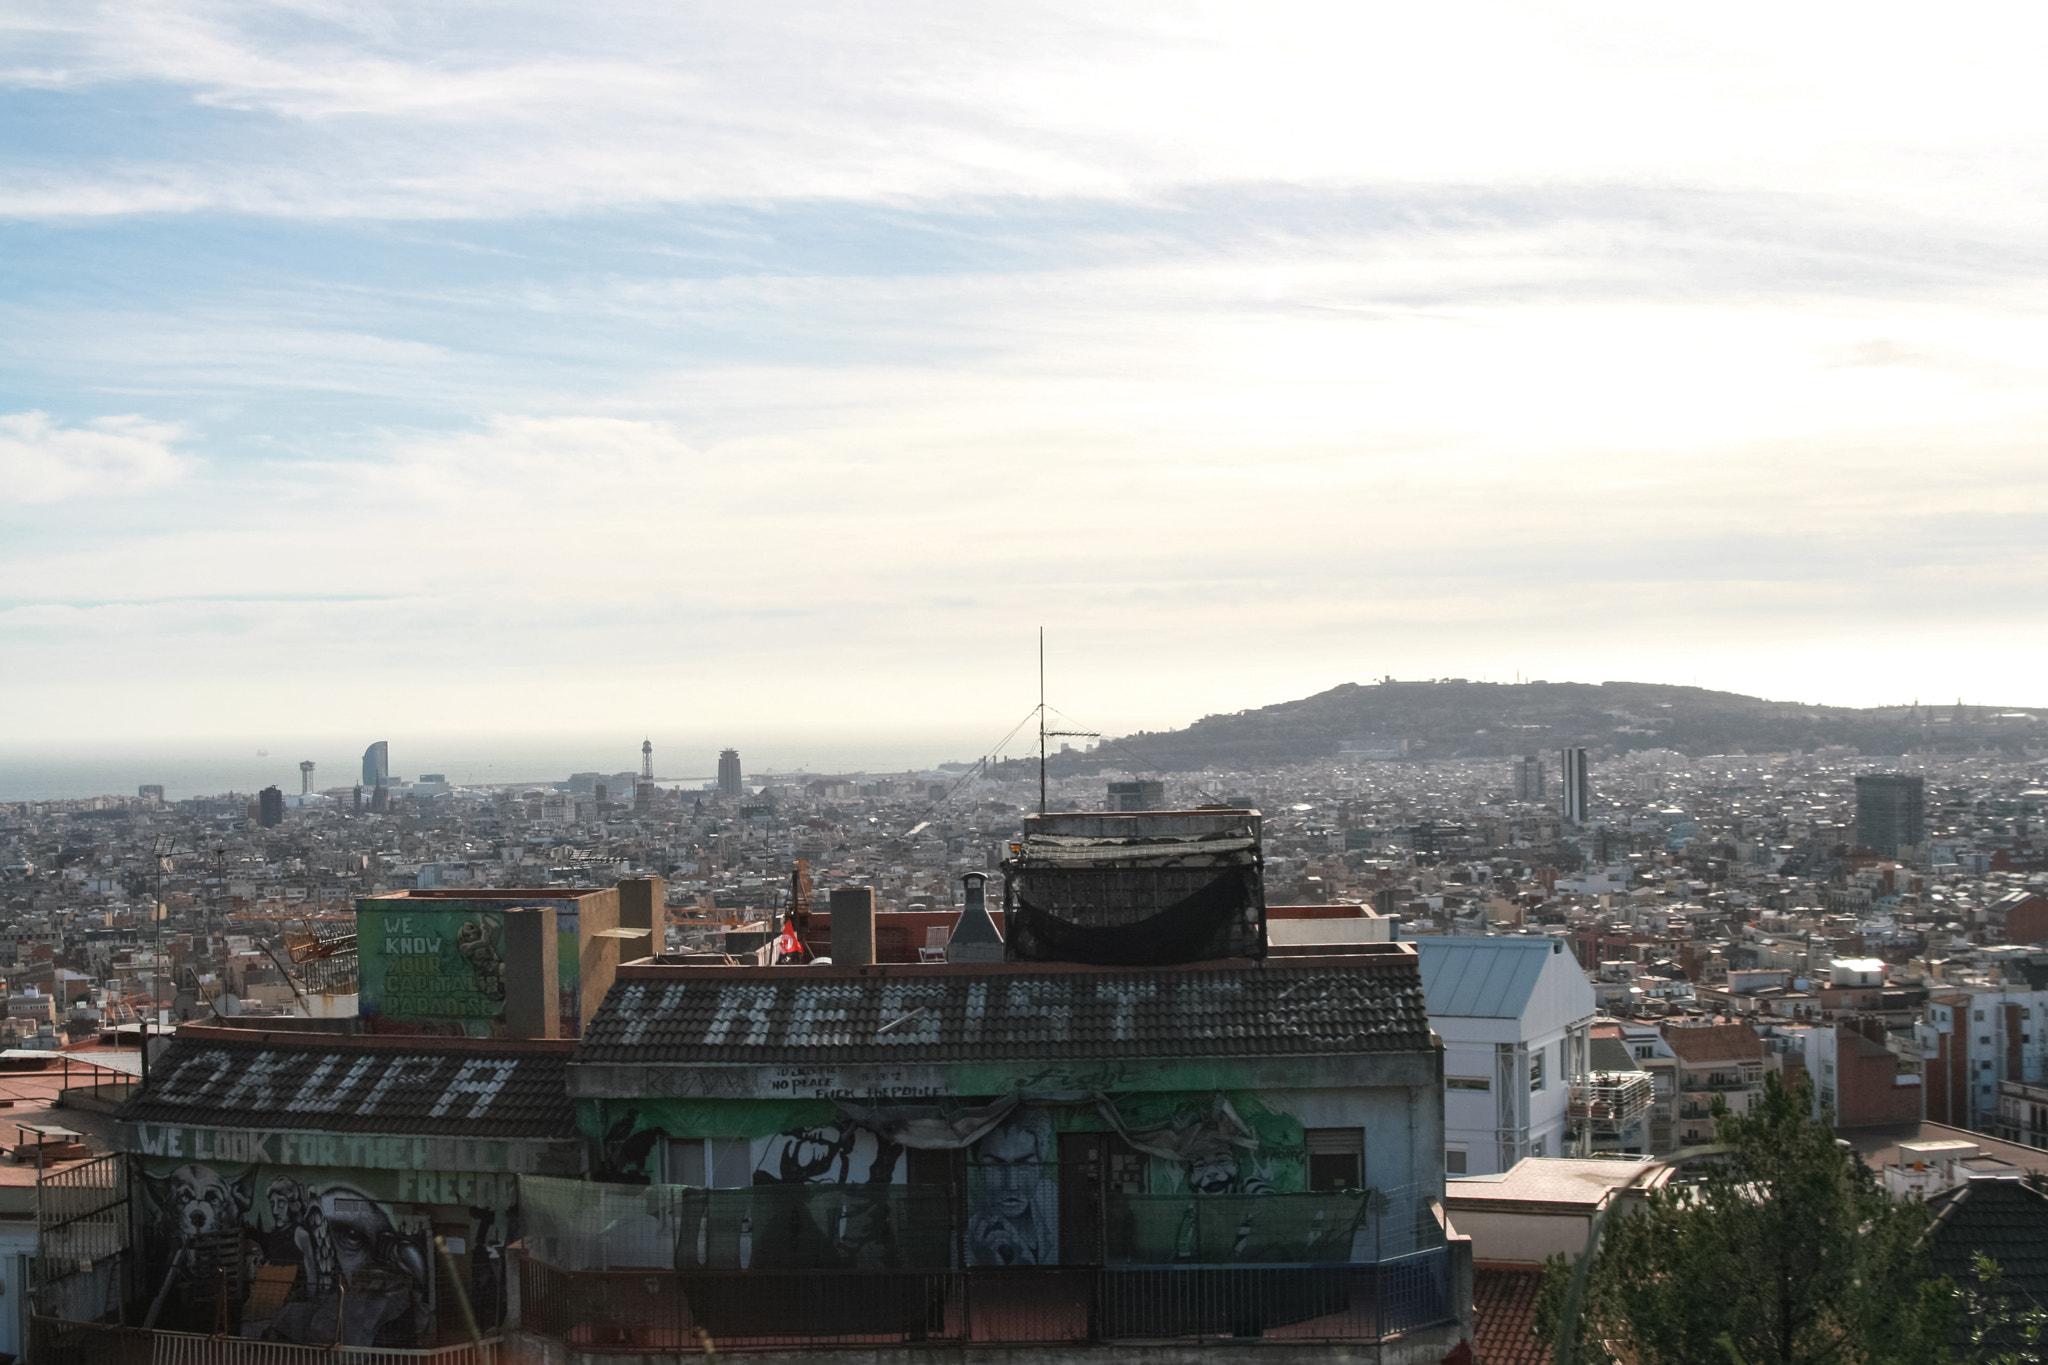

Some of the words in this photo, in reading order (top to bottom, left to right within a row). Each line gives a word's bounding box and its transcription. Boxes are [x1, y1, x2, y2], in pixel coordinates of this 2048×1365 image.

[384, 917, 413, 934] WE
[385, 937, 441, 954] KNOW
[385, 956, 441, 973] YOUR
[158, 1048, 518, 1119] OKUPA
[771, 1079, 789, 1092] NO
[195, 1129, 273, 1164] LOOK
[280, 1134, 338, 1167] FOR
[343, 1136, 407, 1170] THE
